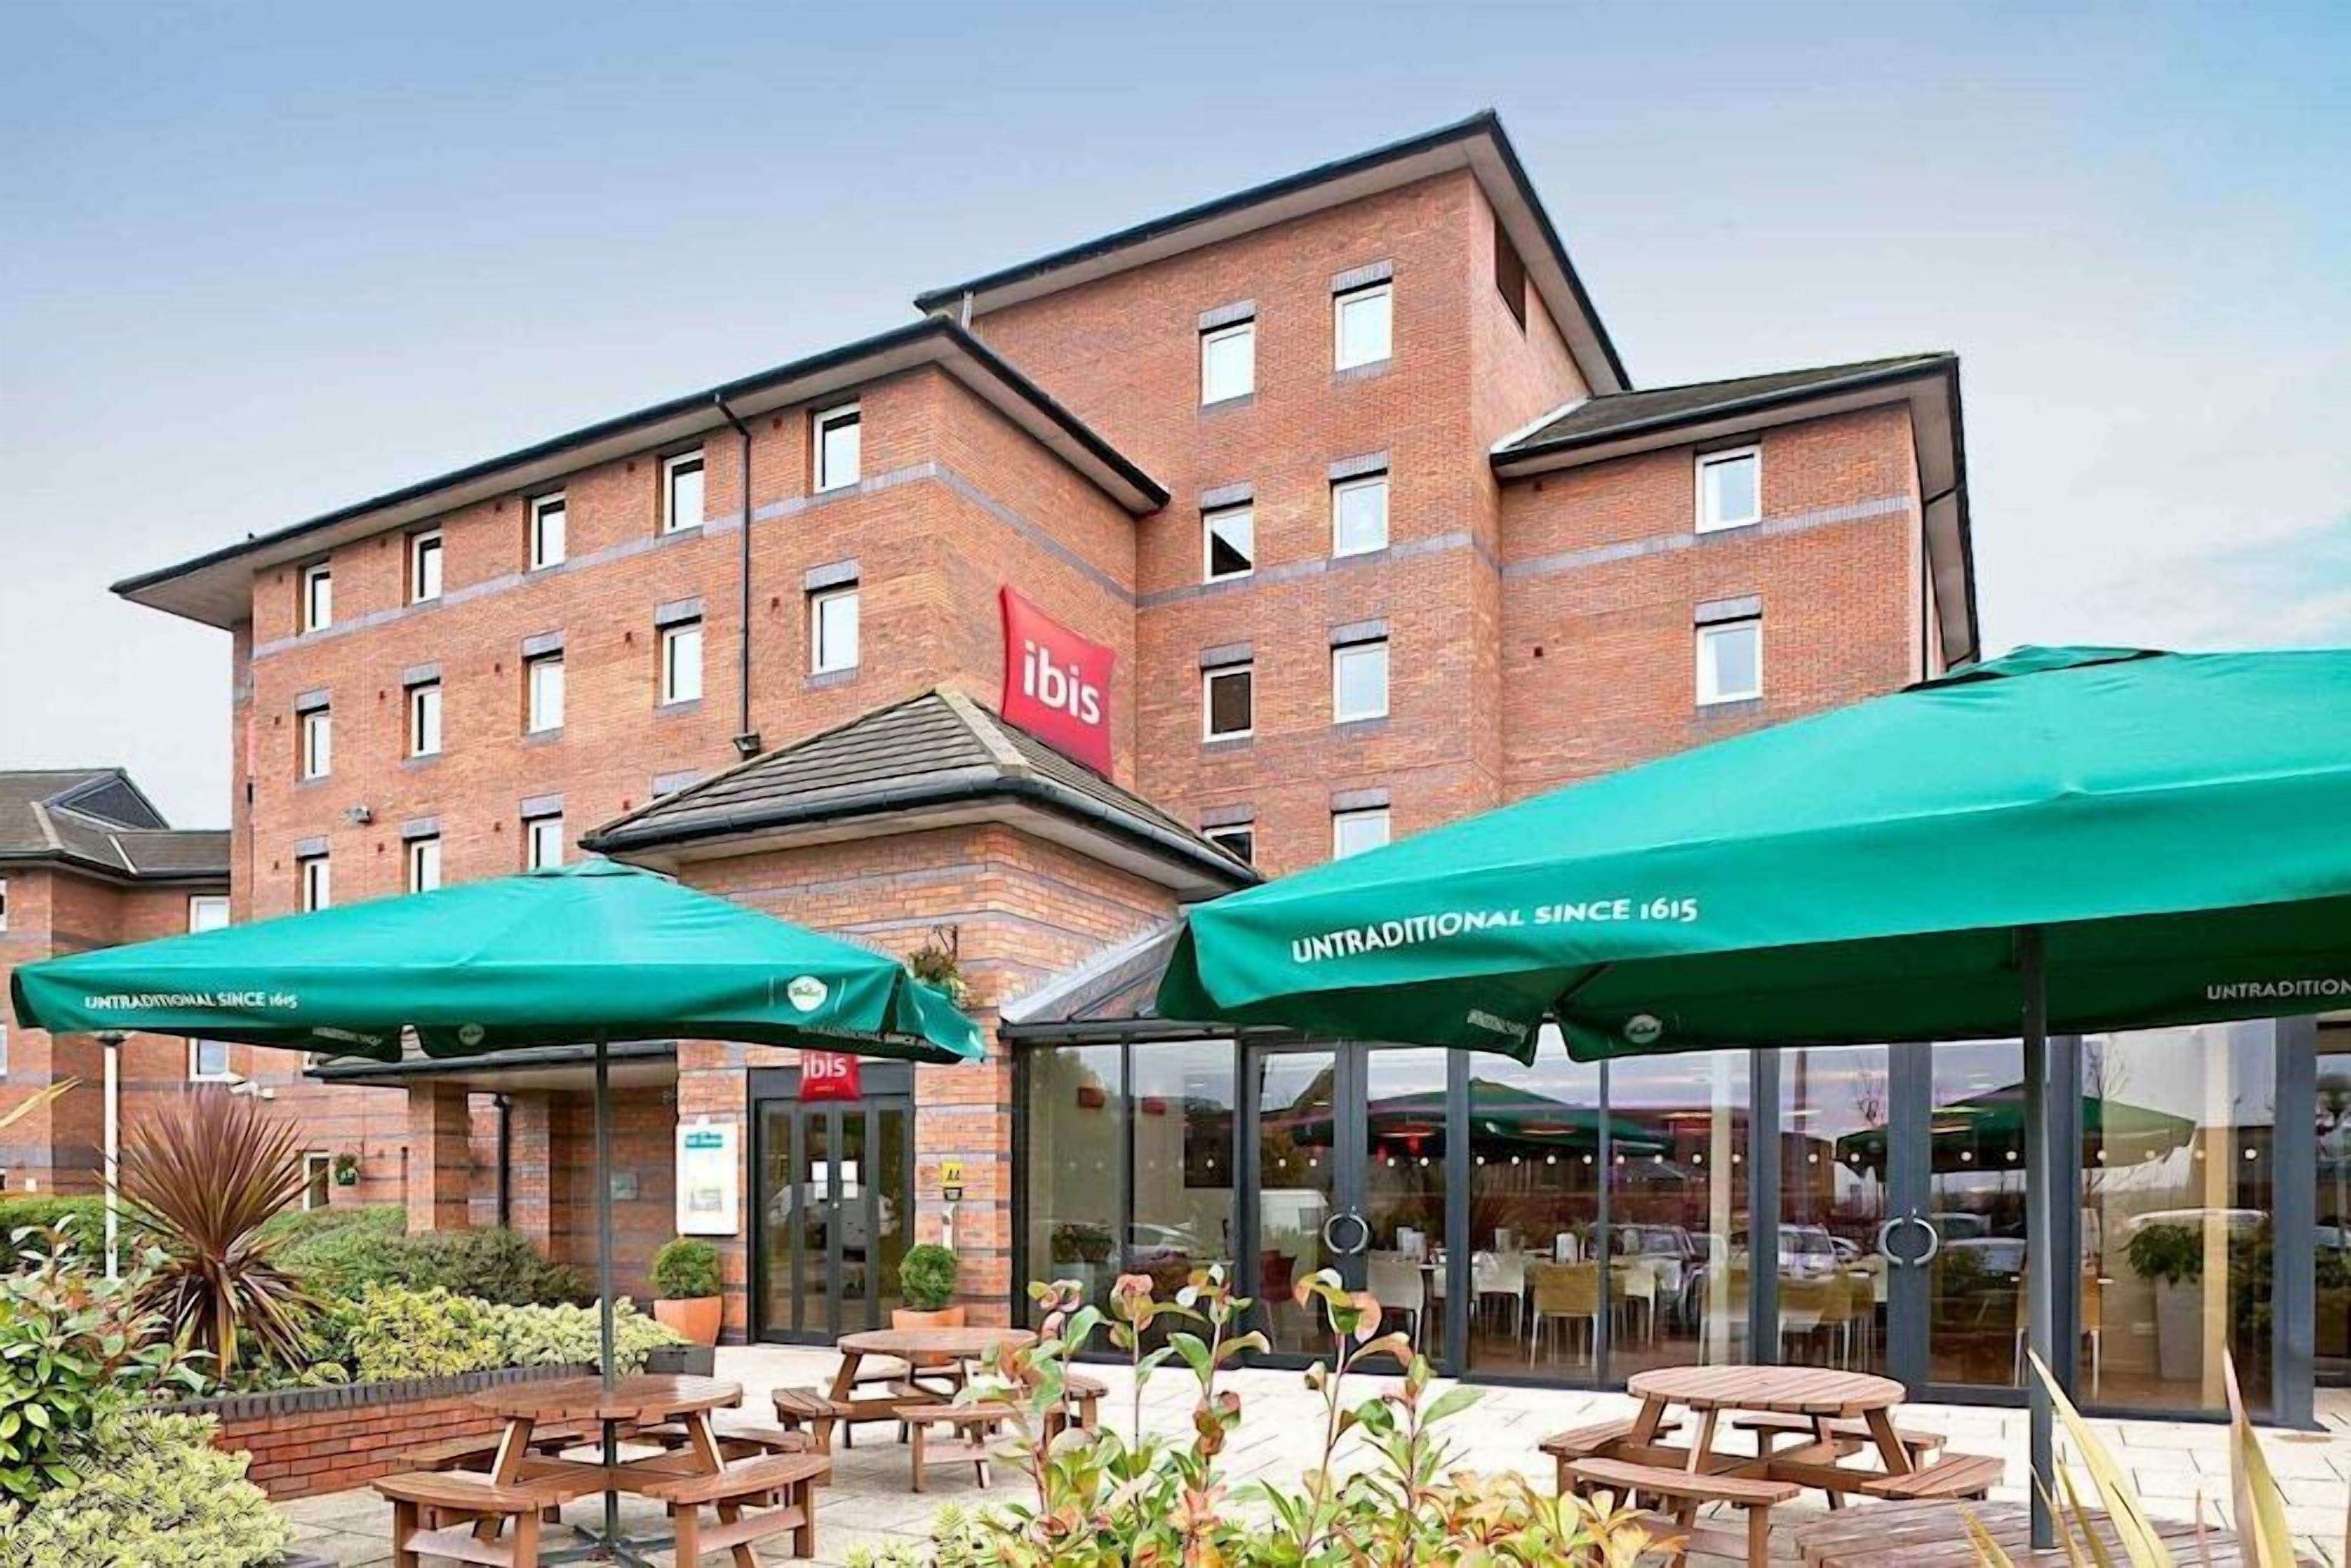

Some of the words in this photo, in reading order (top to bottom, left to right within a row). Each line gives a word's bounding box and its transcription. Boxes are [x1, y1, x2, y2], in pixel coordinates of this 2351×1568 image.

[1023, 639, 1100, 725] ibis
[1291, 909, 1525, 963] UNTRADITIONAL
[1534, 899, 1631, 923] SINCE
[1640, 897, 1699, 922] 1615
[218, 991, 265, 1007] SINCE
[802, 1053, 848, 1080] ibis
